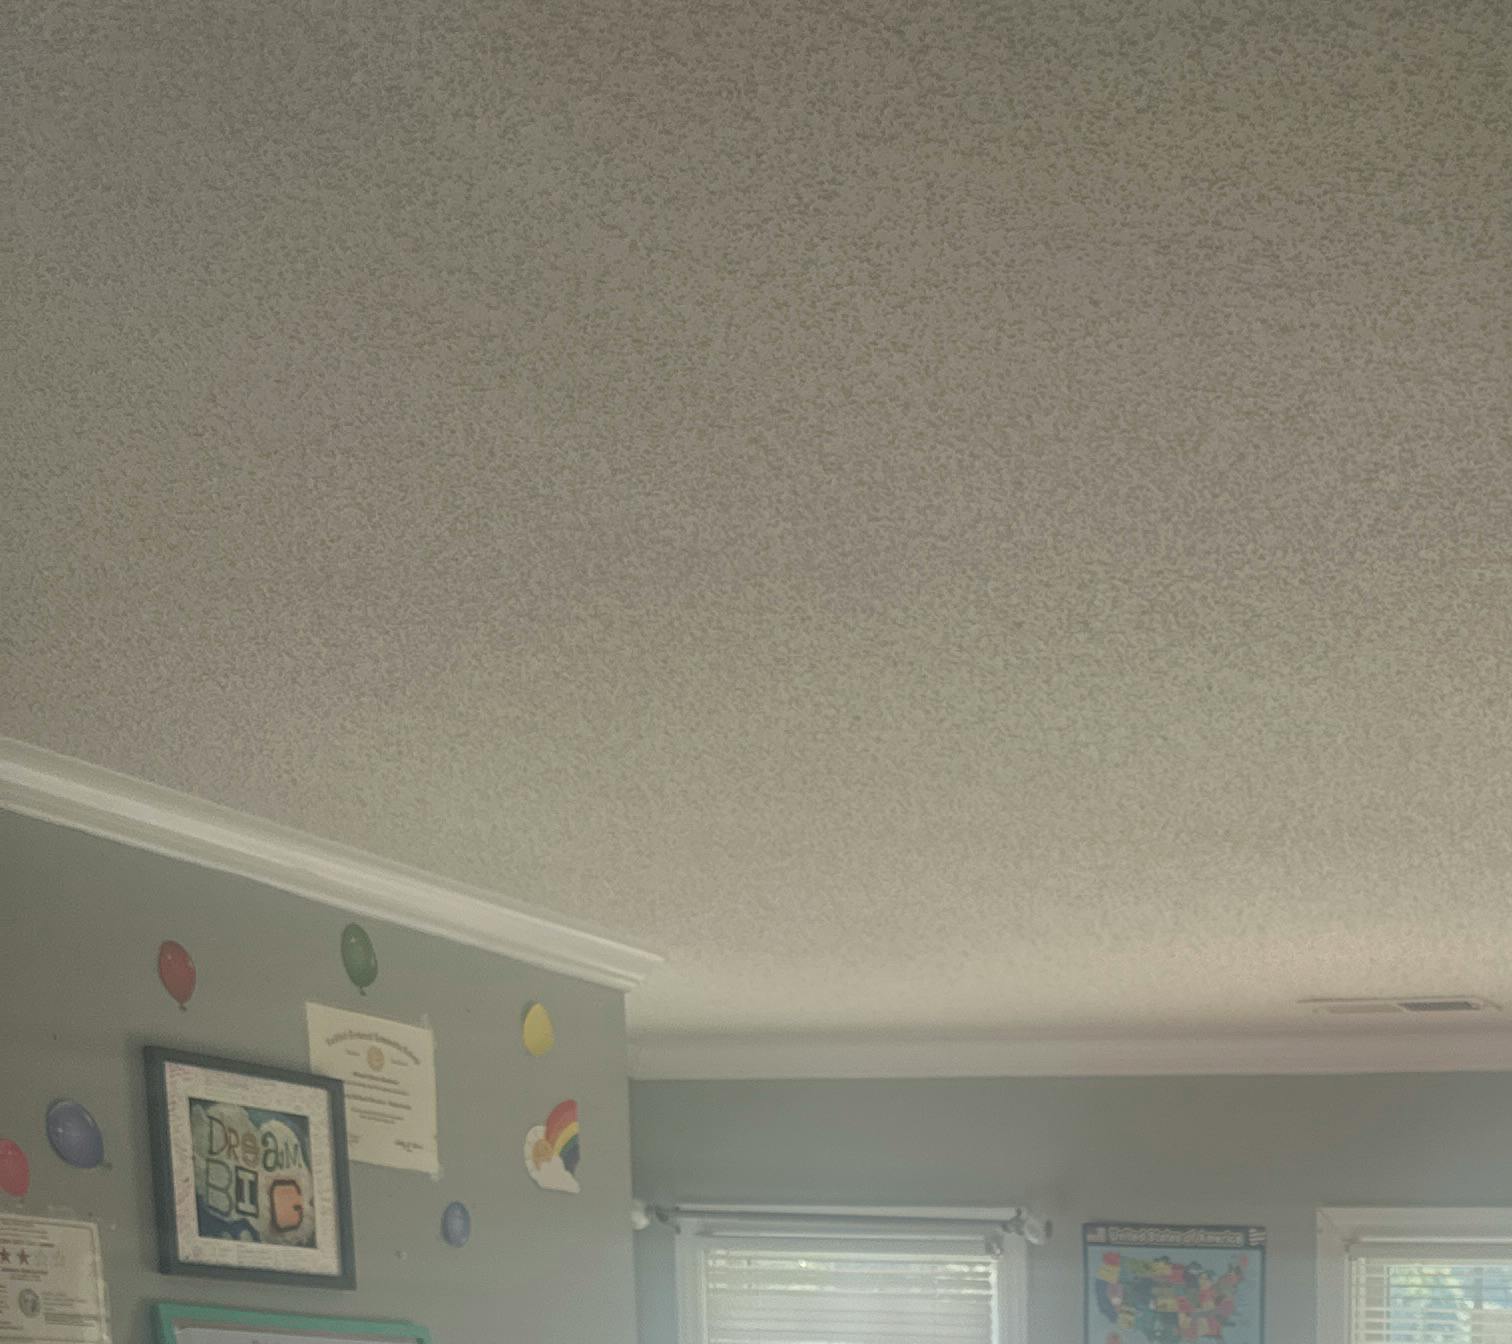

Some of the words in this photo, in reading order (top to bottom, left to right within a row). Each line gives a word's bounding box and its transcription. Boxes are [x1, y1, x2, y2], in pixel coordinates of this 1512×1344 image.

[206, 1158, 304, 1233] BIG
[1109, 1228, 1146, 1243] United
[1148, 1229, 1180, 1243] States
[1199, 1230, 1243, 1246] America
